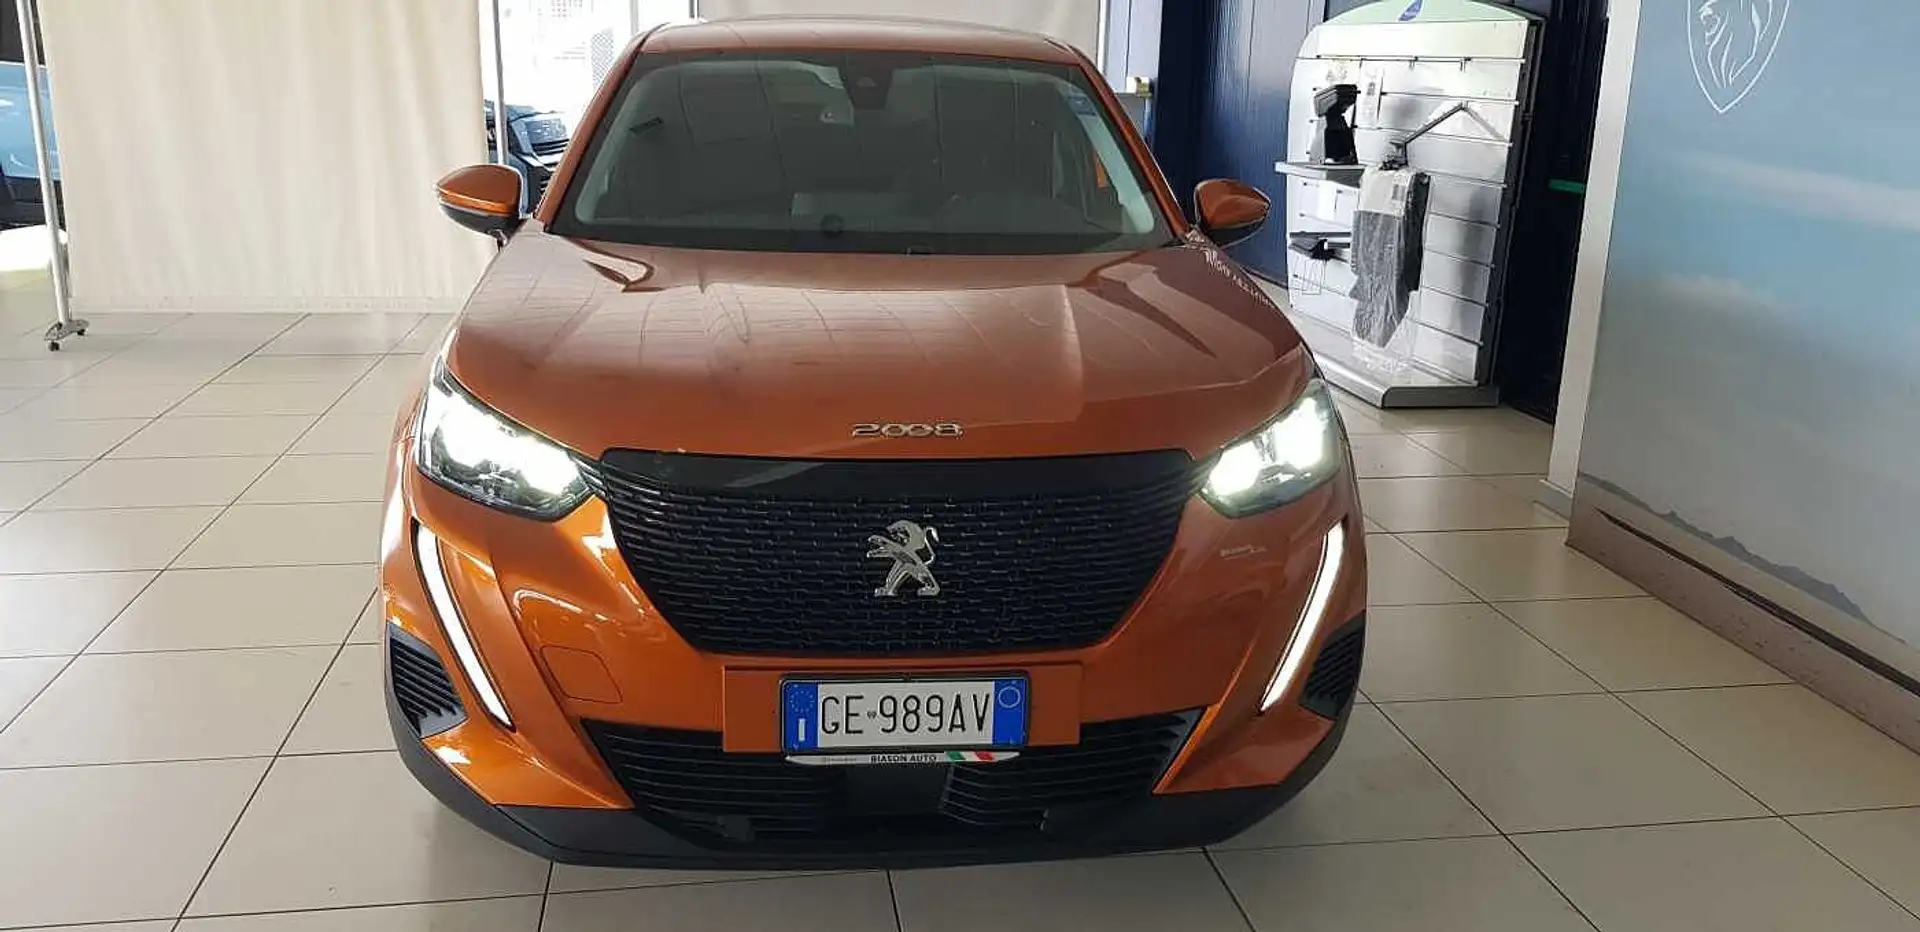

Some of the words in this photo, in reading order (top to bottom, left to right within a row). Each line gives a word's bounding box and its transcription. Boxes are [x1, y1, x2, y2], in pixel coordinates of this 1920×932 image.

[852, 423, 963, 438] 2008
[820, 695, 864, 734] GE
[878, 694, 990, 733] 989AV
[870, 754, 908, 764] BIASON
[910, 754, 938, 763] AUTO
